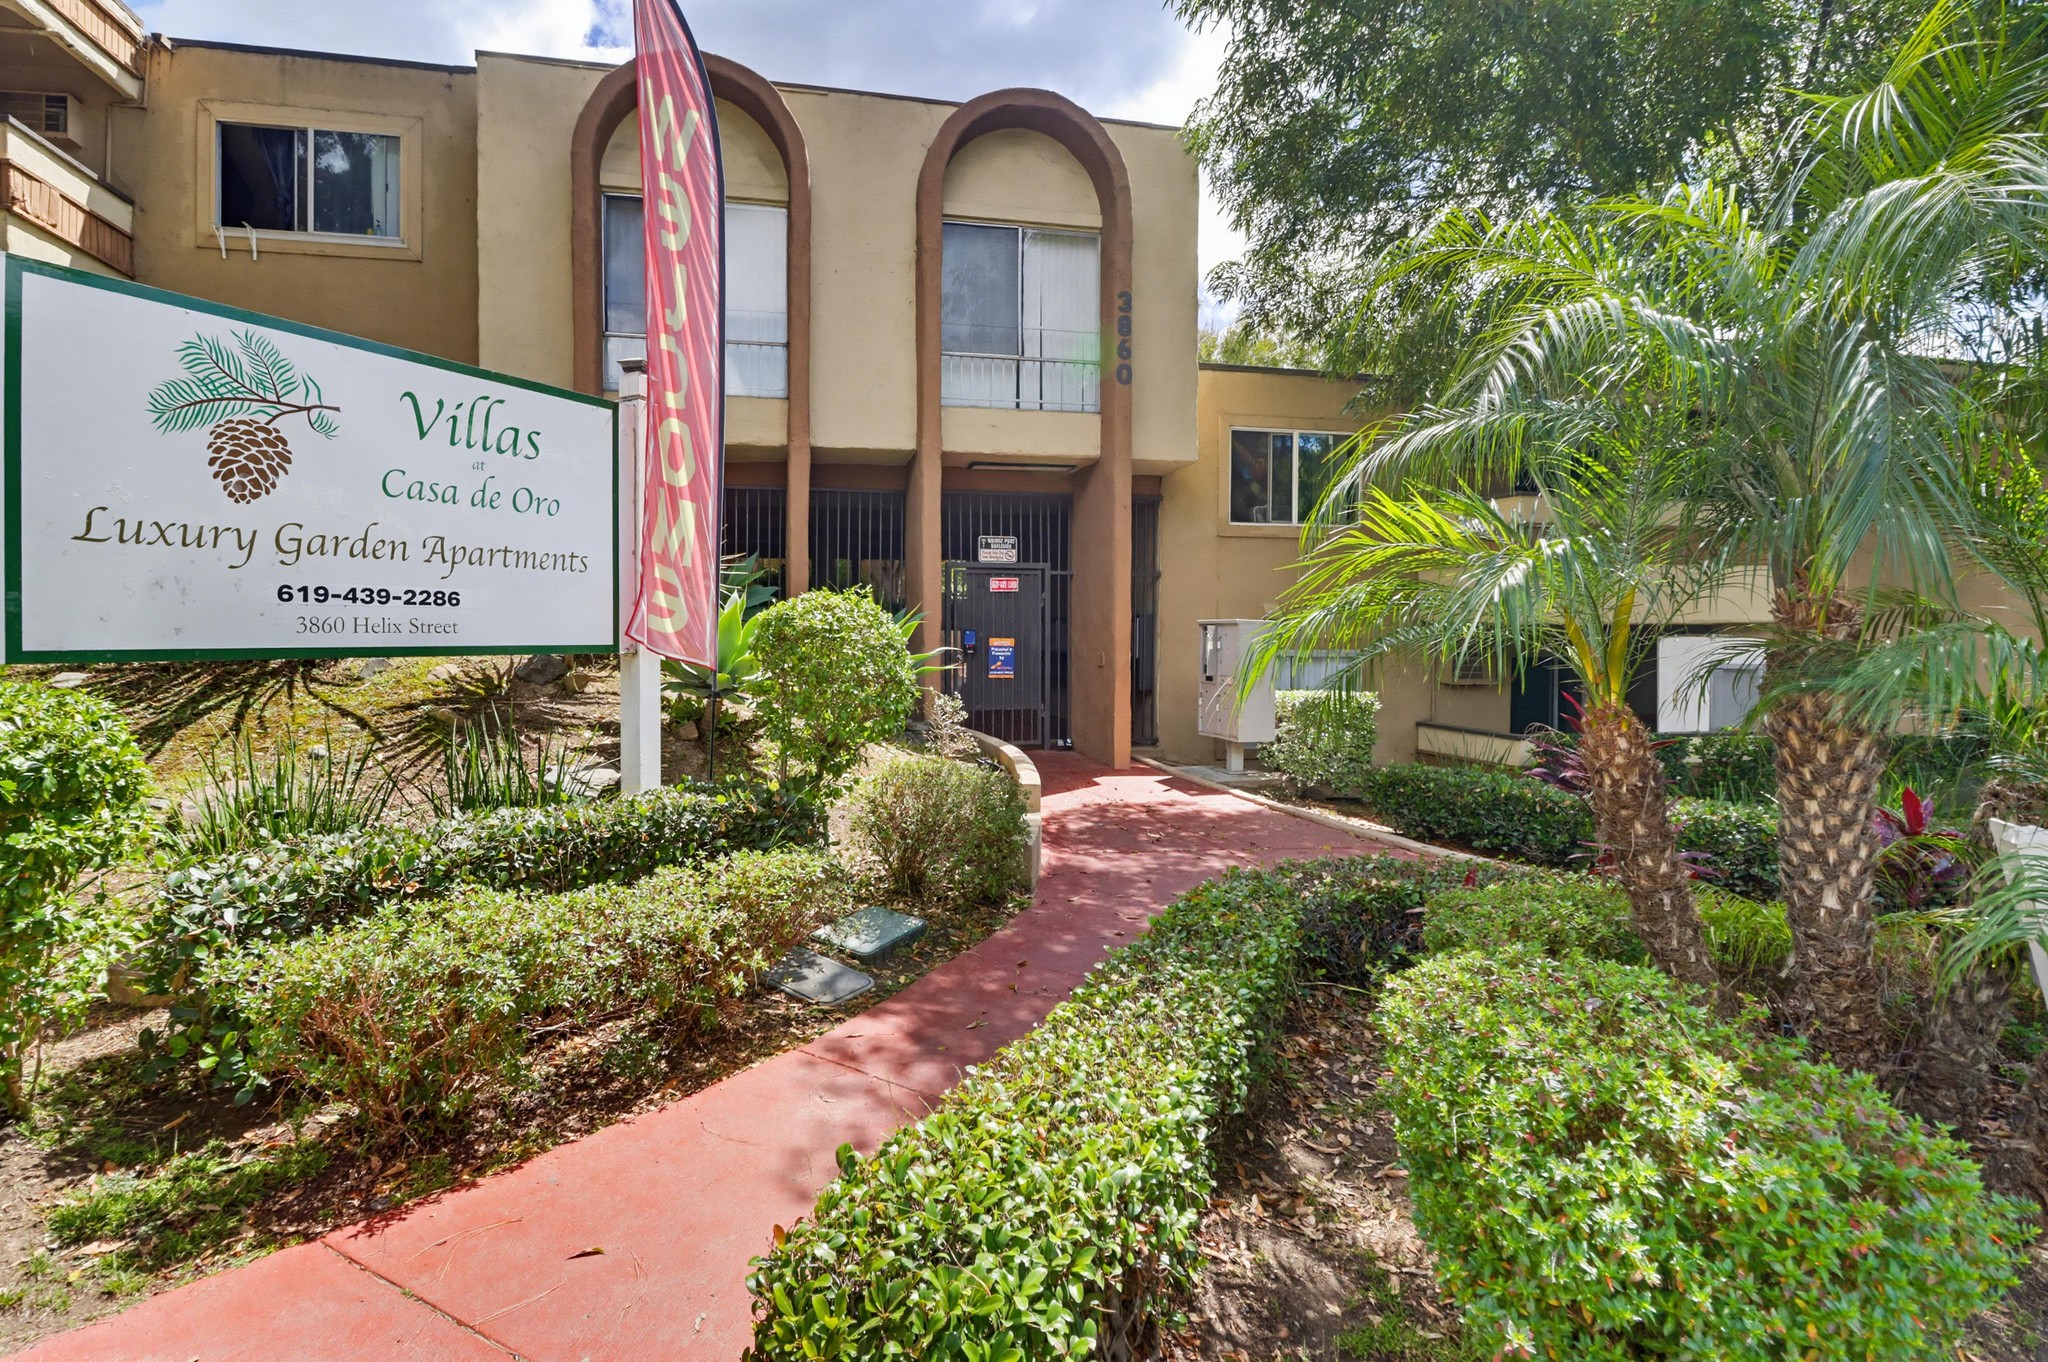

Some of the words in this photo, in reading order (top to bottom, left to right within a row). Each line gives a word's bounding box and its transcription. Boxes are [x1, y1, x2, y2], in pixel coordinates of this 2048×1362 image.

[1116, 290, 1132, 385] 3860
[399, 390, 542, 460] Villas
[472, 459, 486, 472] at
[381, 468, 459, 505] Casa
[470, 475, 501, 510] de
[512, 487, 560, 517] Oro
[71, 506, 258, 570] Luxury
[274, 522, 410, 567] Garden
[422, 535, 588, 580] Apartments
[276, 584, 461, 607] 619-439-2286
[295, 616, 345, 634] 3860
[353, 616, 402, 634] Helix
[408, 616, 458, 634] Street
